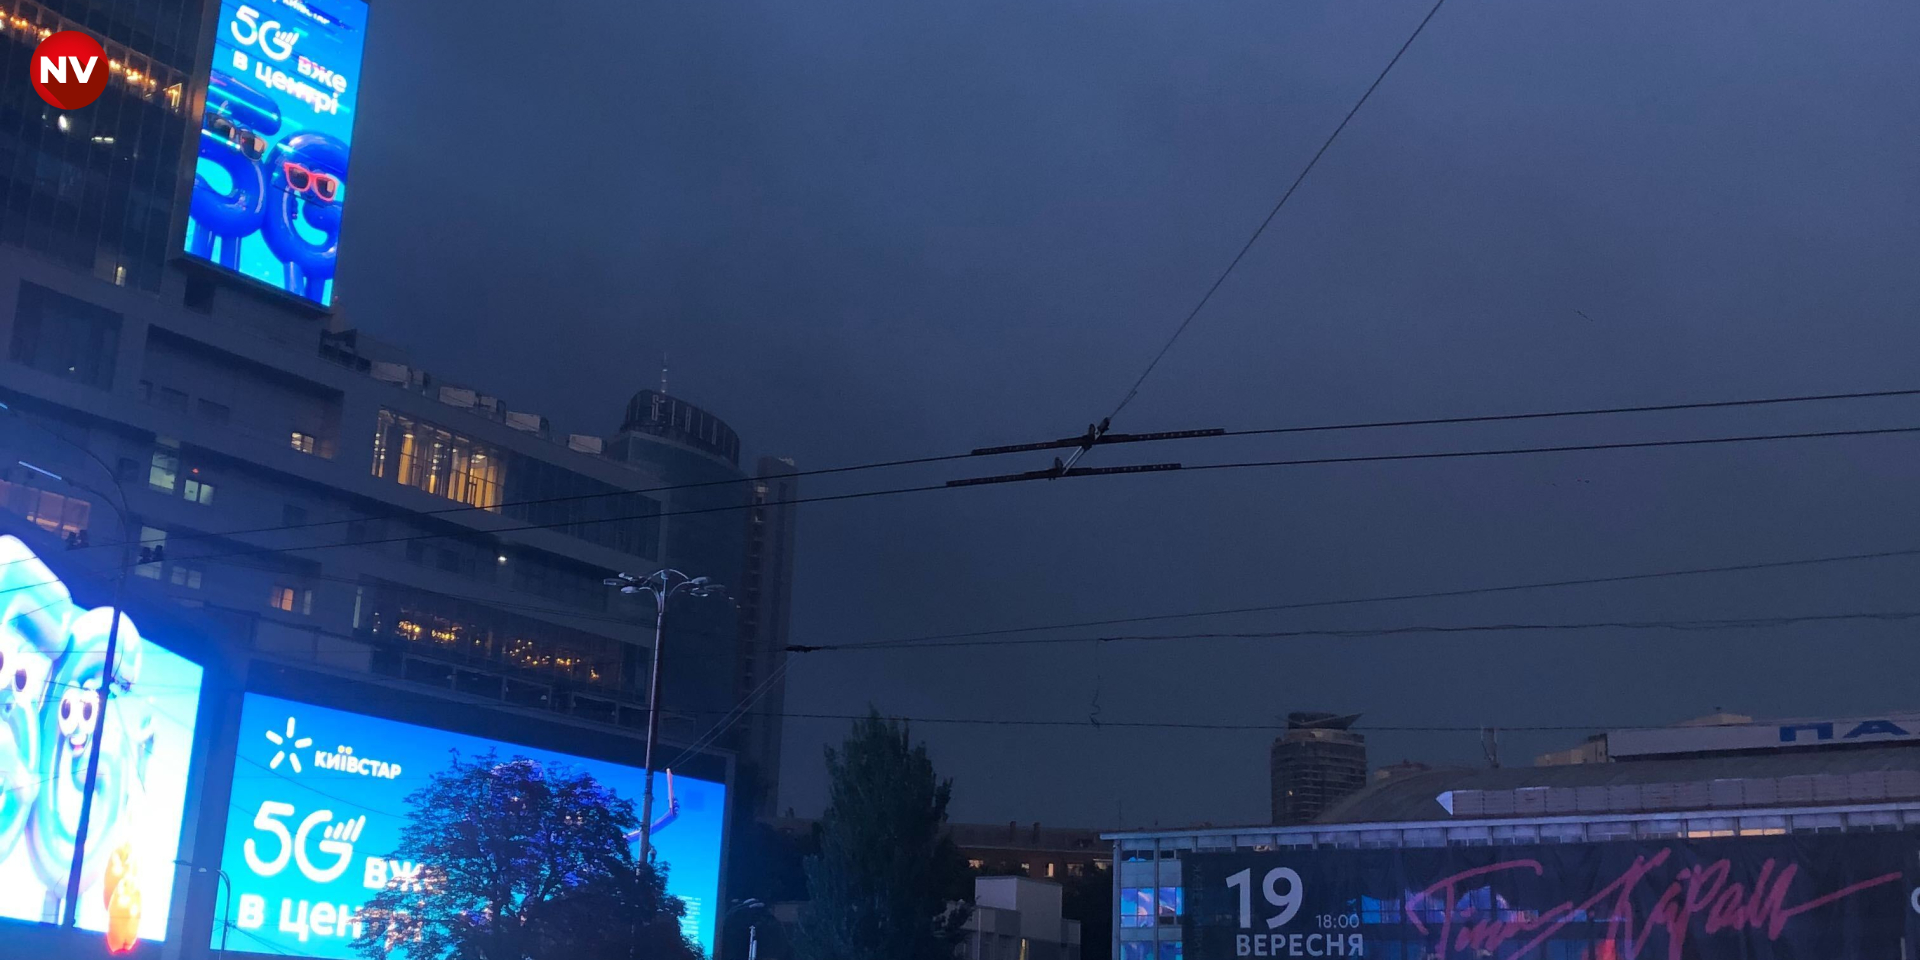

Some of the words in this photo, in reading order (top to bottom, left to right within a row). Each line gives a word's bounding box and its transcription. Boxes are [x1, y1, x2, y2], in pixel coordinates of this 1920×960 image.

[231, 5, 299, 61] 5G
[314, 745, 401, 779] КИЇВСТАР
[243, 800, 366, 883] 5G
[1225, 866, 1303, 929] 19
[1315, 914, 1360, 929] 18:00
[1236, 933, 1364, 956] ВЕРЕСНЯ
